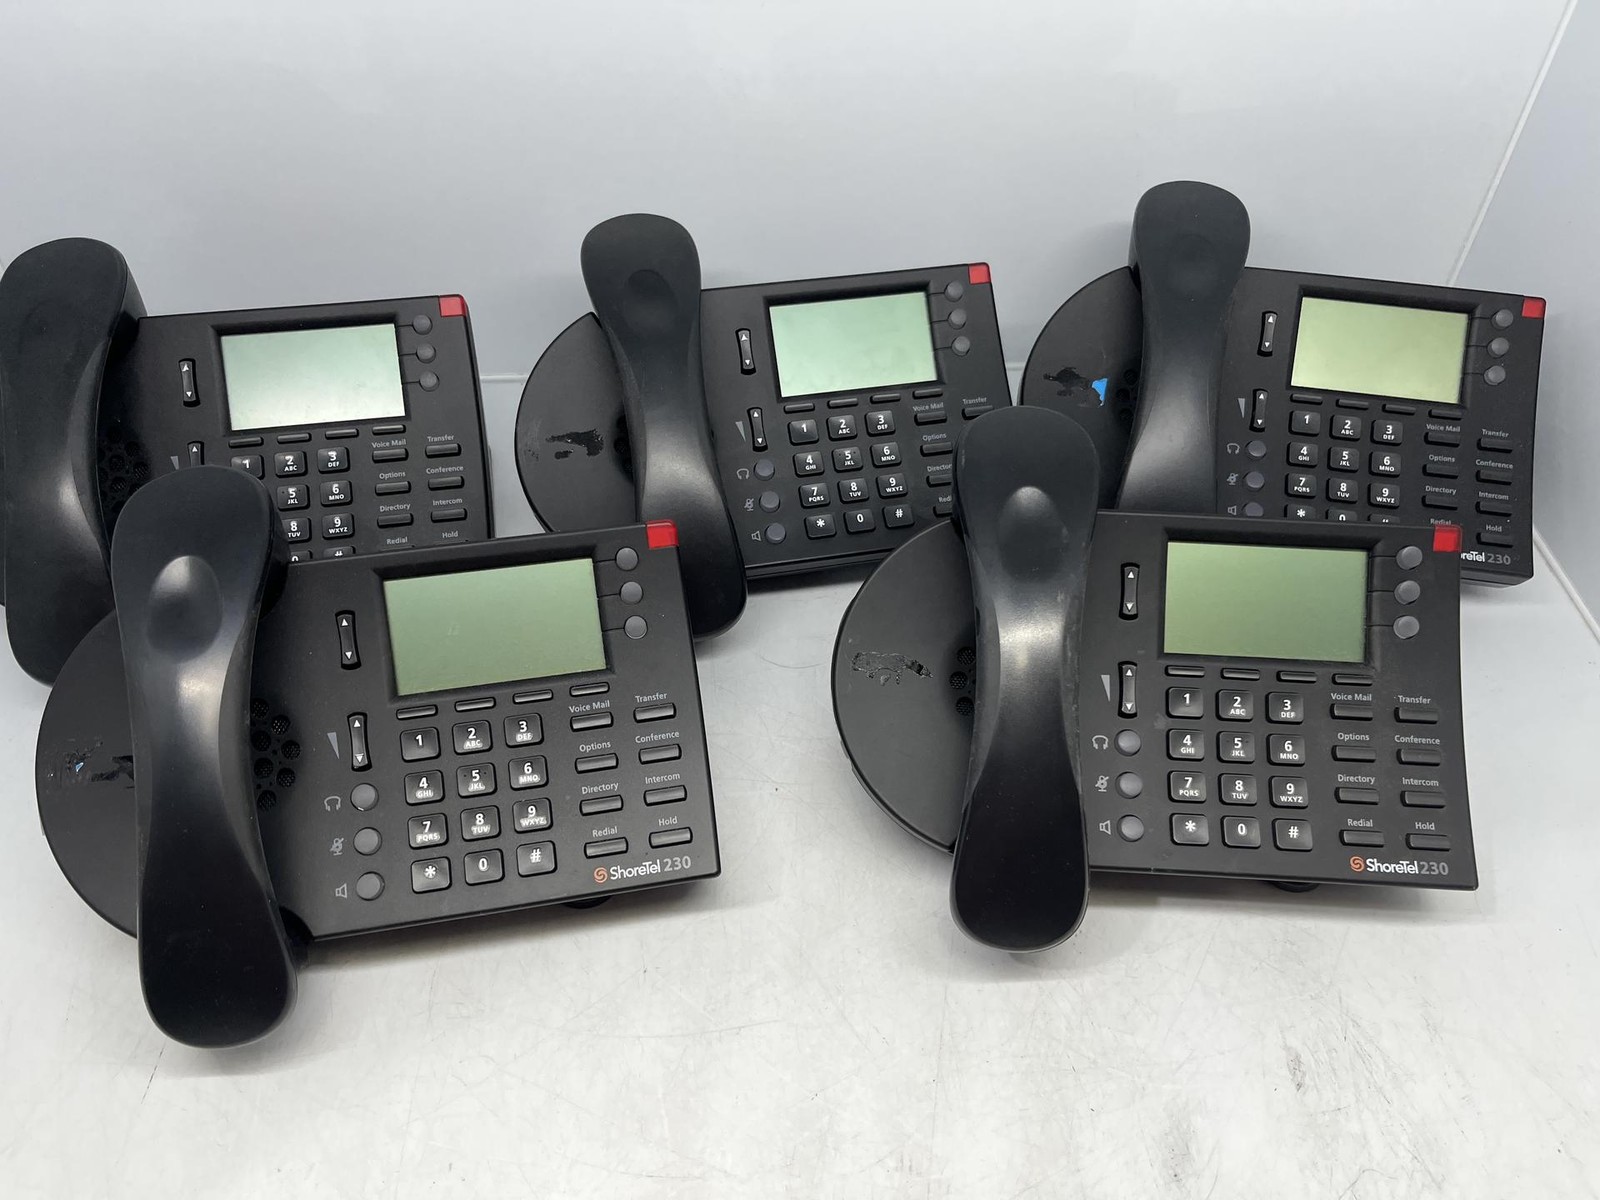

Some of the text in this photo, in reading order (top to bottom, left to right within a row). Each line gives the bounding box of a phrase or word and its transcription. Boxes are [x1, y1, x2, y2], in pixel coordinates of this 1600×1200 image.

[930, 402, 943, 410] Mail
[839, 419, 846, 428] 2
[878, 415, 885, 425] 3
[1305, 415, 1309, 423] 1
[801, 423, 806, 432] 1
[1345, 420, 1351, 429] 2
[1386, 425, 1392, 434] 3
[1482, 429, 1509, 437] Transfer
[427, 434, 454, 442] Transfer
[844, 451, 851, 459] 5
[884, 446, 890, 455] 6
[1301, 446, 1307, 455] 4
[285, 456, 293, 464] 2
[328, 451, 337, 461] 3
[807, 455, 813, 463] 4
[1342, 451, 1348, 460] 5
[1429, 454, 1455, 462] Options
[242, 459, 250, 468] 1
[1384, 457, 1390, 465] 6
[1476, 459, 1513, 469] Conference
[426, 466, 463, 474] Conference
[927, 464, 952, 472] Director
[379, 472, 405, 480] Options
[890, 477, 896, 486] 9
[1300, 477, 1305, 486] 7
[333, 484, 339, 493] 6
[851, 482, 857, 491] 8
[1340, 483, 1346, 491] 8
[1426, 486, 1456, 495] Directory
[288, 488, 296, 497] 5
[811, 487, 819, 497] 7
[1381, 488, 1388, 498] 9
[1479, 491, 1508, 500] Intercom
[380, 504, 410, 512] Directory
[857, 514, 863, 522] 0
[896, 509, 903, 518] #
[291, 521, 297, 531] 8
[334, 517, 341, 527] 9
[1461, 550, 1511, 565] reTel 230
[635, 693, 667, 702] Transfer
[1184, 694, 1189, 705] 1
[1233, 697, 1241, 707] 2
[1398, 695, 1431, 704] Transfer
[569, 700, 610, 713] Voice Mail
[1284, 700, 1291, 710] 3
[520, 721, 527, 733] 3
[468, 728, 476, 739] 2
[517, 732, 532, 741] DEF
[635, 732, 679, 743] Conference
[1338, 733, 1369, 741] Options
[416, 735, 422, 746] 1
[465, 740, 481, 748] ABC
[1183, 735, 1192, 746] 4
[1234, 738, 1242, 748] 5
[1395, 735, 1440, 744] Conference
[580, 742, 611, 752] Options
[1285, 741, 1292, 751] 6
[524, 763, 532, 774] 6
[472, 770, 479, 781] 5
[520, 774, 540, 783] MNO
[645, 774, 680, 784] Intercom
[1338, 774, 1375, 784] Directory
[420, 777, 428, 789] 4
[469, 782, 485, 790] JKL
[1185, 777, 1192, 788] 7
[1236, 780, 1243, 791] 8
[1403, 777, 1439, 786] Intercom
[582, 783, 618, 794] Directory
[1287, 783, 1294, 794] 9
[417, 789, 433, 798] GHI
[528, 806, 537, 817] 9
[476, 814, 484, 825] 8
[520, 817, 546, 826] WXYZ
[659, 816, 677, 826] Hold
[1348, 819, 1373, 827] Redial
[423, 821, 430, 833] 7
[472, 825, 489, 834] TUV
[1238, 824, 1247, 835] 0
[1415, 822, 1435, 830] Hold
[593, 826, 617, 837] Redial
[1288, 826, 1299, 838] #
[417, 832, 440, 842] PQRS
[530, 849, 541, 863] #
[479, 858, 488, 870] 0
[610, 856, 691, 880] ShoreTel 230
[1366, 859, 1448, 875] ShoreTel 230
